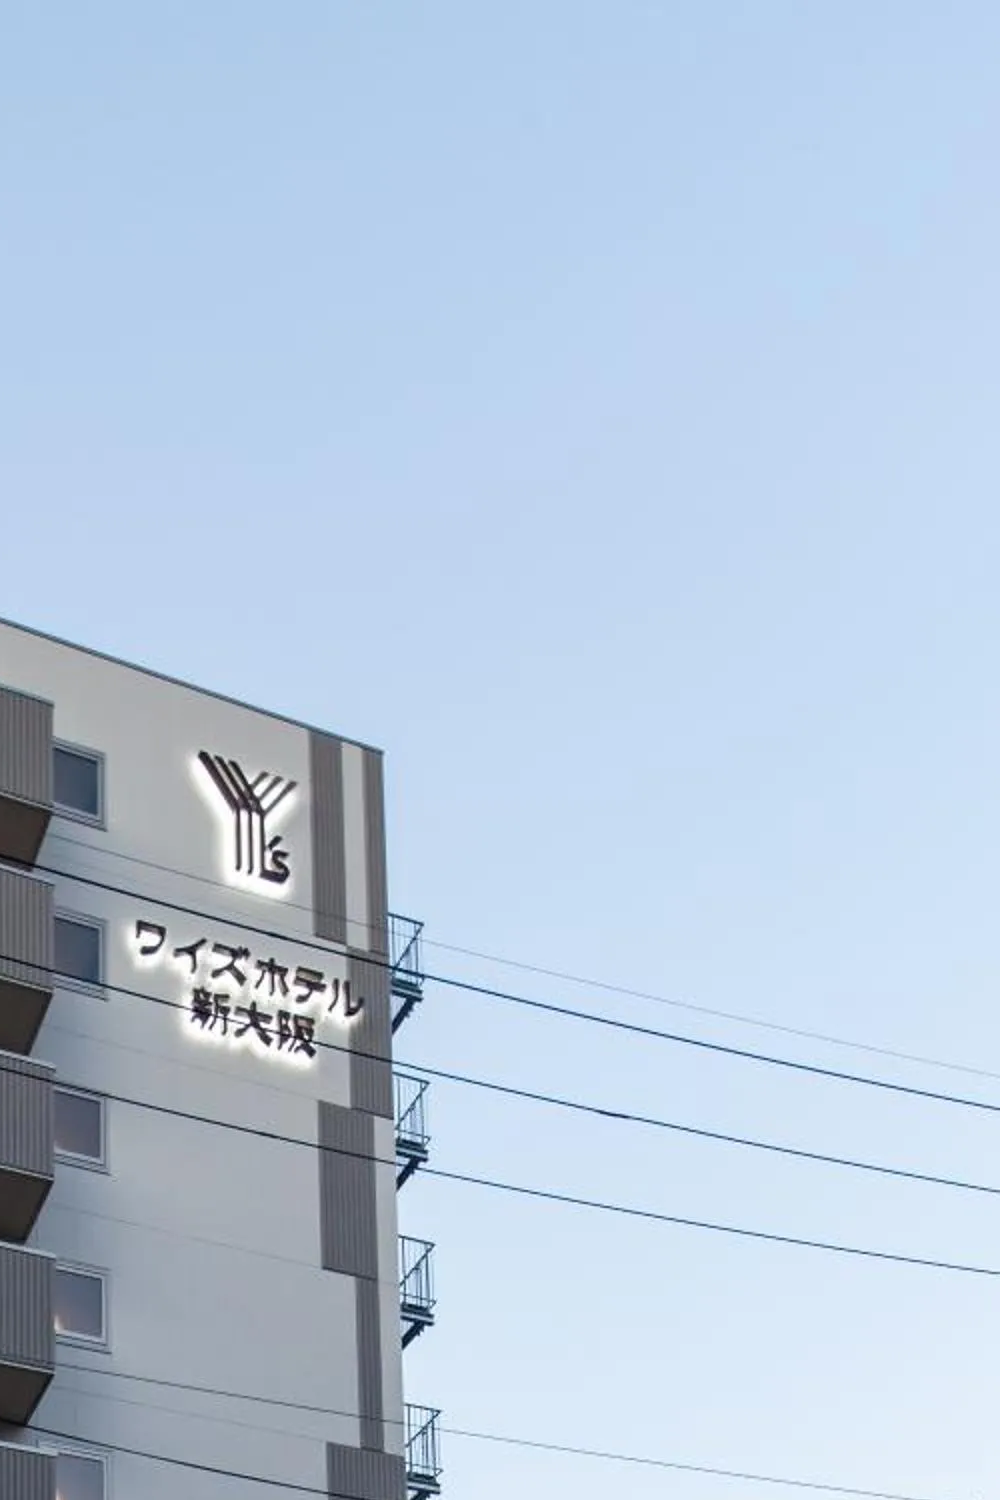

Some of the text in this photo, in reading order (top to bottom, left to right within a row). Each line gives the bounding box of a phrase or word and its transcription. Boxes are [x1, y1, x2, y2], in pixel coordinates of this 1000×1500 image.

[135, 919, 364, 1018] ワイズホテル
[190, 987, 317, 1059] 新大阪
